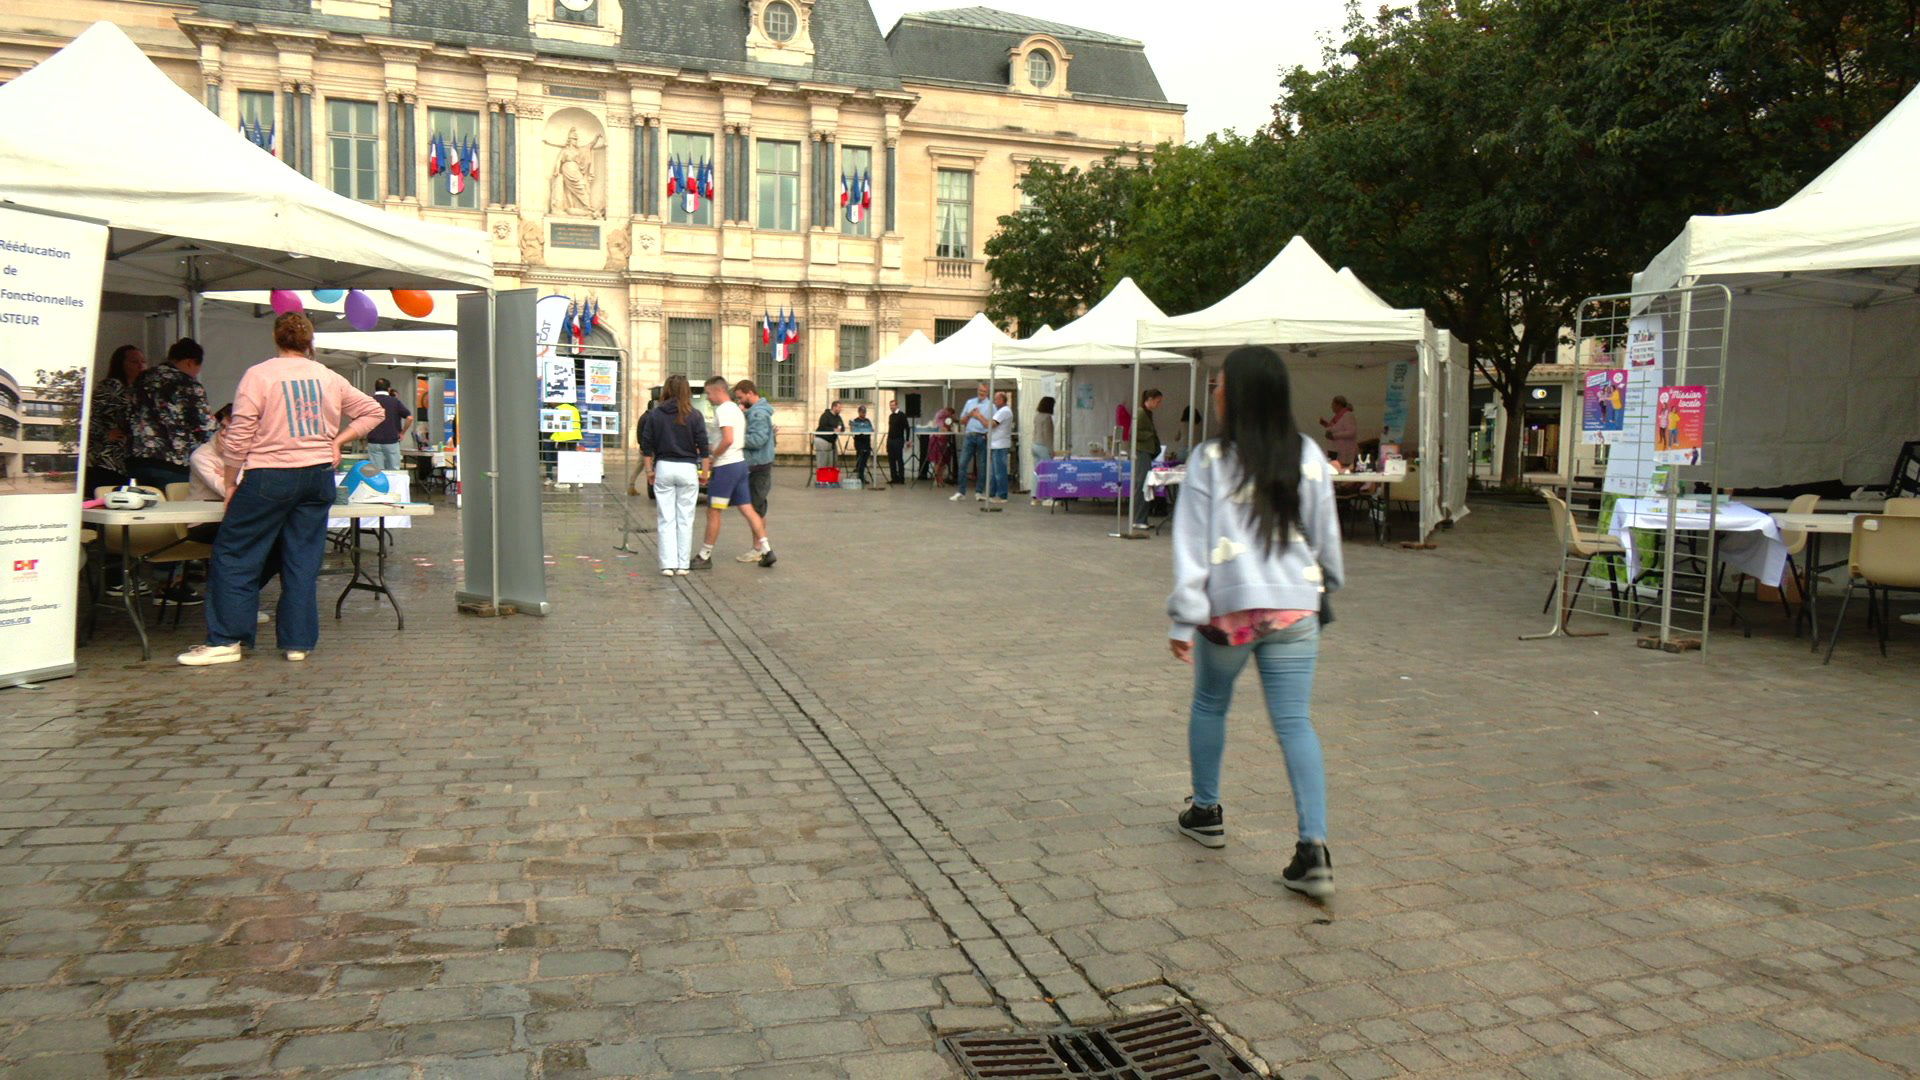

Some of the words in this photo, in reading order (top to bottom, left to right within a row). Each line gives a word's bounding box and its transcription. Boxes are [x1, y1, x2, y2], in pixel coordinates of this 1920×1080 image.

[0, 239, 71, 259] Rééducation
[3, 264, 18, 276] de
[0, 288, 84, 307] Fonctionnelles
